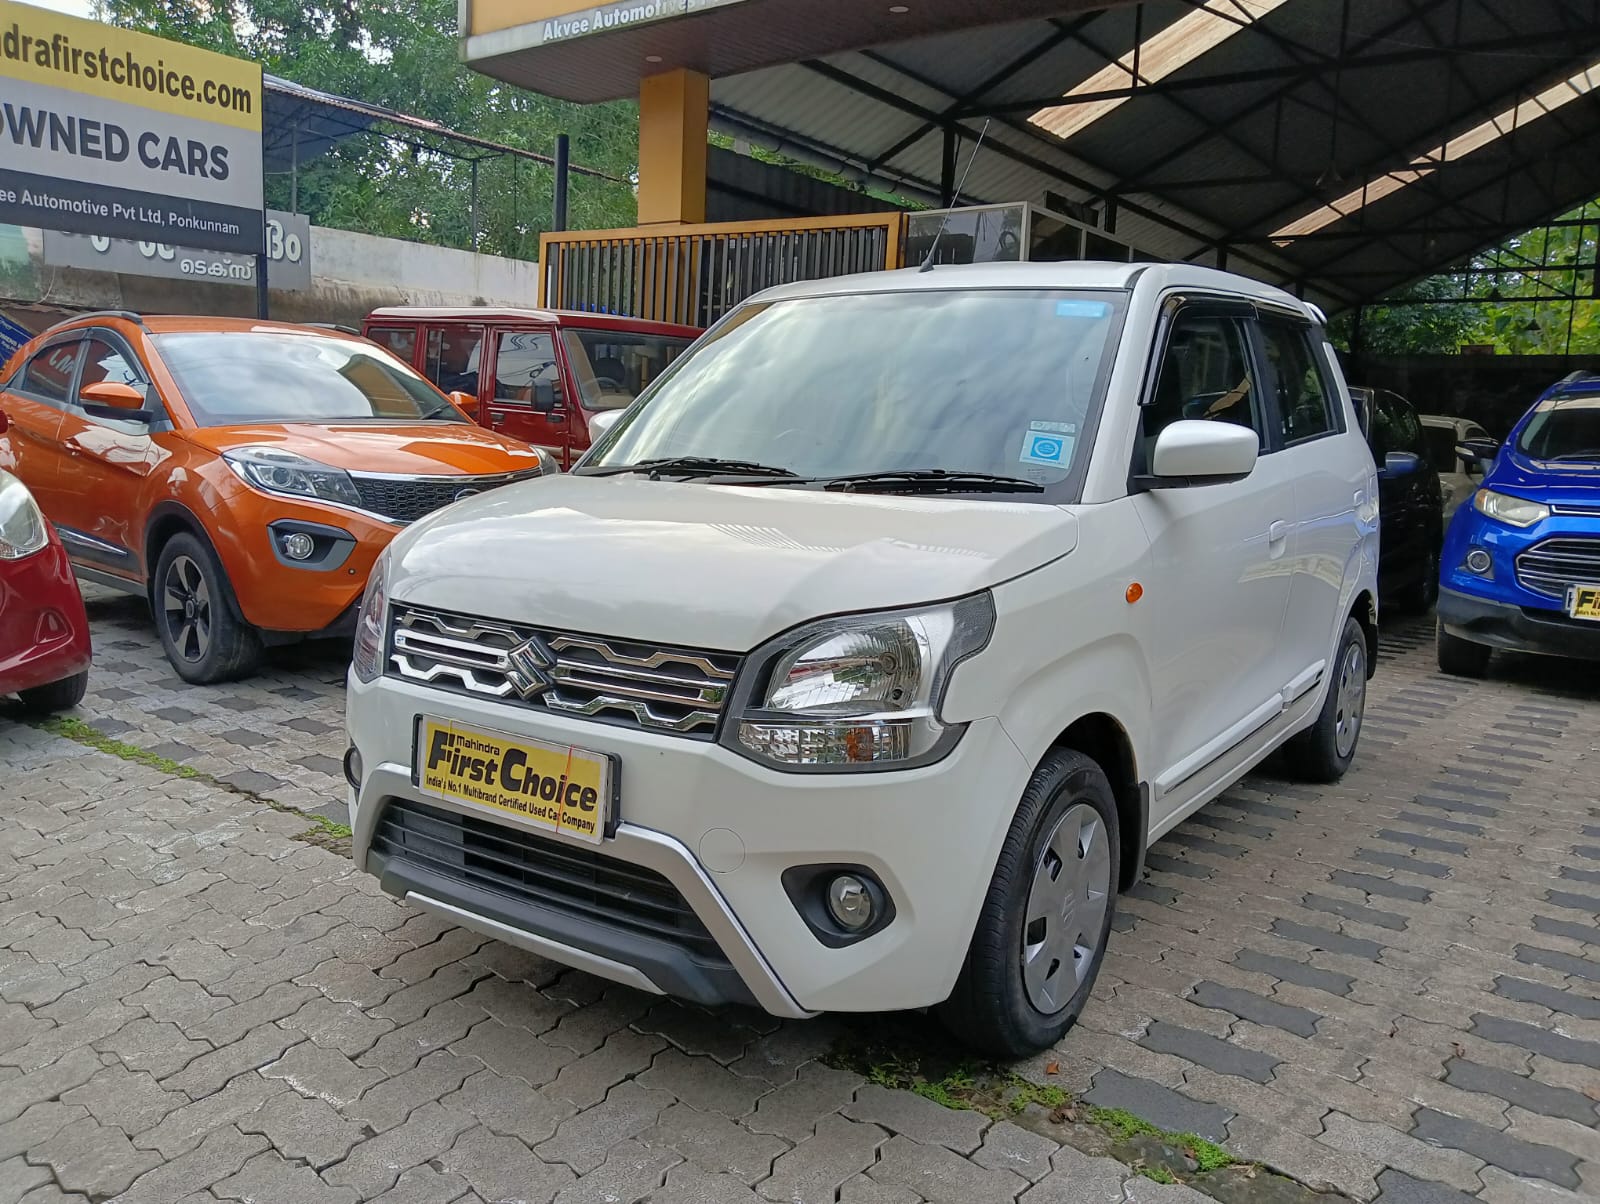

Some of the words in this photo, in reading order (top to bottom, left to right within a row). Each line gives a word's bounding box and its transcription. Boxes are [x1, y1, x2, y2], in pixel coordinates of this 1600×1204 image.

[543, 19, 589, 41] Akvee
[0, 23, 251, 114] drafirstchoice.com
[0, 102, 130, 162] WNED
[137, 131, 230, 181] CARS
[21, 189, 109, 217] Automotive
[112, 203, 137, 221] Pvt
[139, 207, 165, 226] Ltd,
[168, 212, 240, 235] Ponkunnam
[428, 730, 499, 785] First
[500, 748, 598, 812] Choice
[456, 735, 500, 756] Mahindra
[426, 774, 447, 790] India's
[463, 783, 497, 804] Multibrand
[498, 793, 528, 812] Certified
[529, 801, 547, 818] Used
[561, 811, 596, 834] Company
